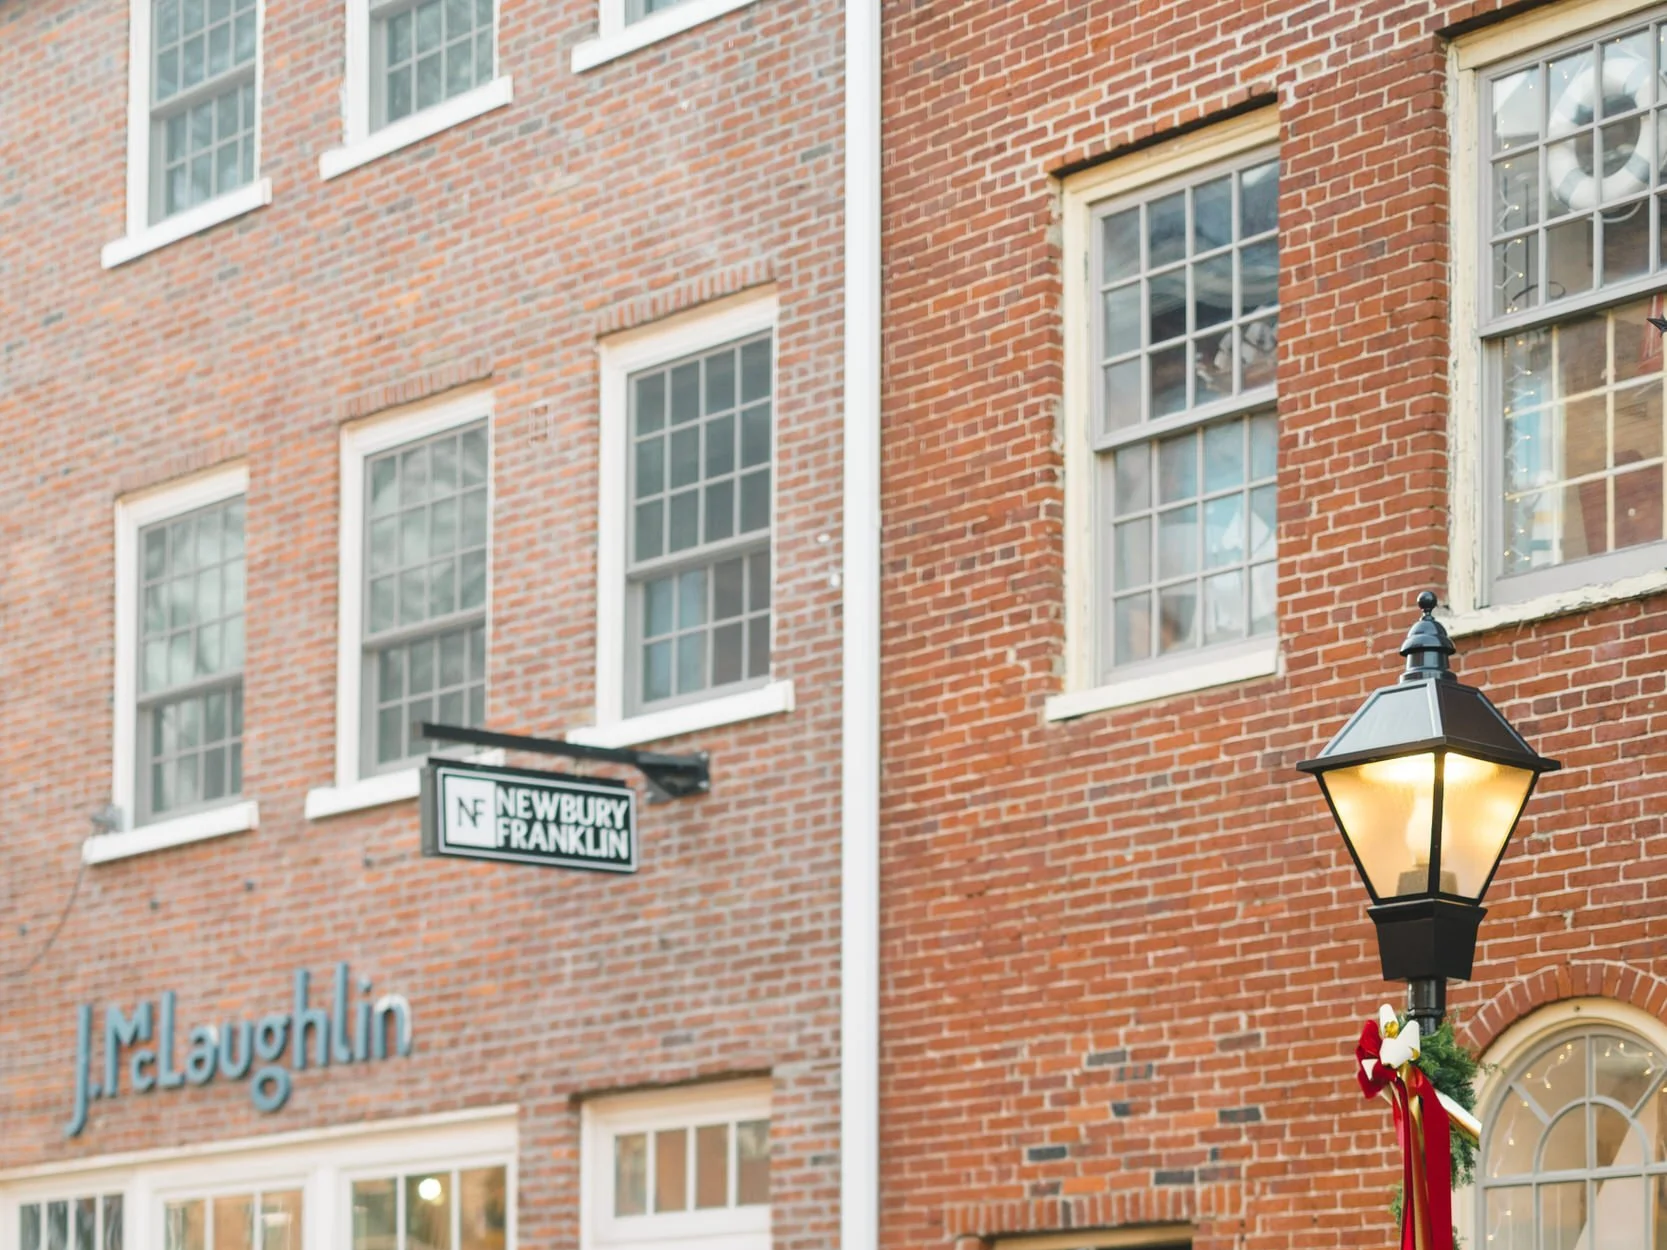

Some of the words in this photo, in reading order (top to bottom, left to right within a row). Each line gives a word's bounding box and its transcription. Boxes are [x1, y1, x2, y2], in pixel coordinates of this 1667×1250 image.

[457, 796, 485, 828] NF
[496, 785, 629, 829] NEWBURY
[496, 817, 629, 860] FRANKLIN
